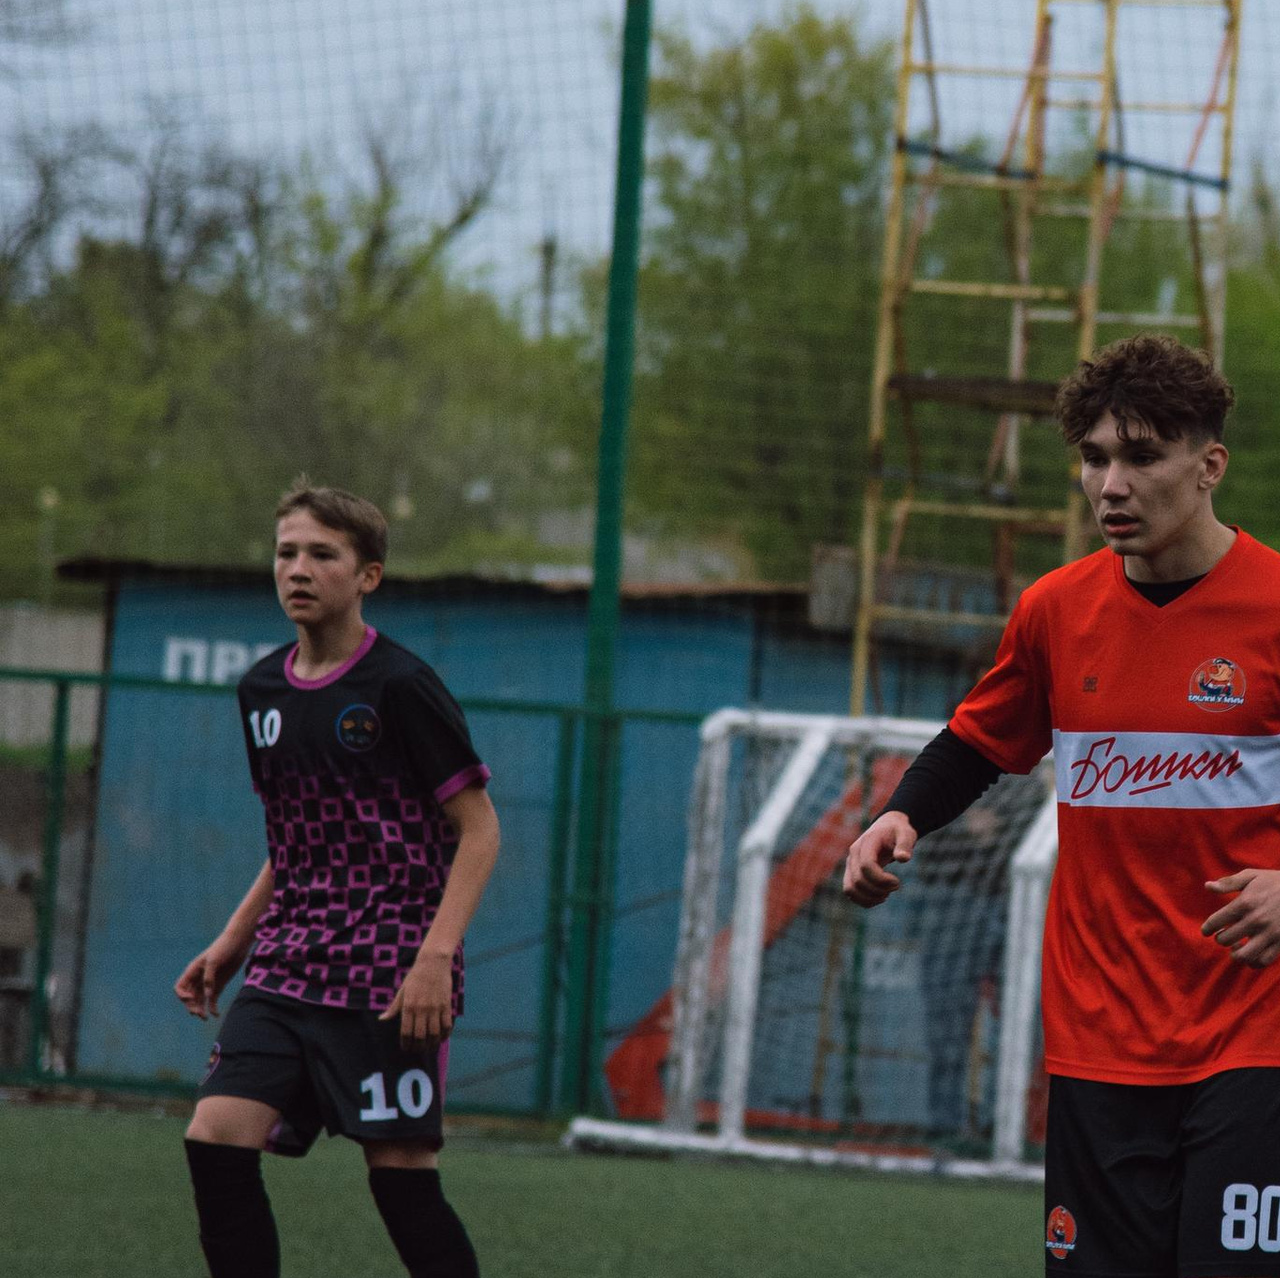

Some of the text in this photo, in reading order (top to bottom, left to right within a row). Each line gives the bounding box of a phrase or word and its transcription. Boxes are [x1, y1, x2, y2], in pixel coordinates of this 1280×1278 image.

[163, 636, 283, 686] ПР
[250, 708, 282, 749] 10
[360, 1068, 433, 1122] 10
